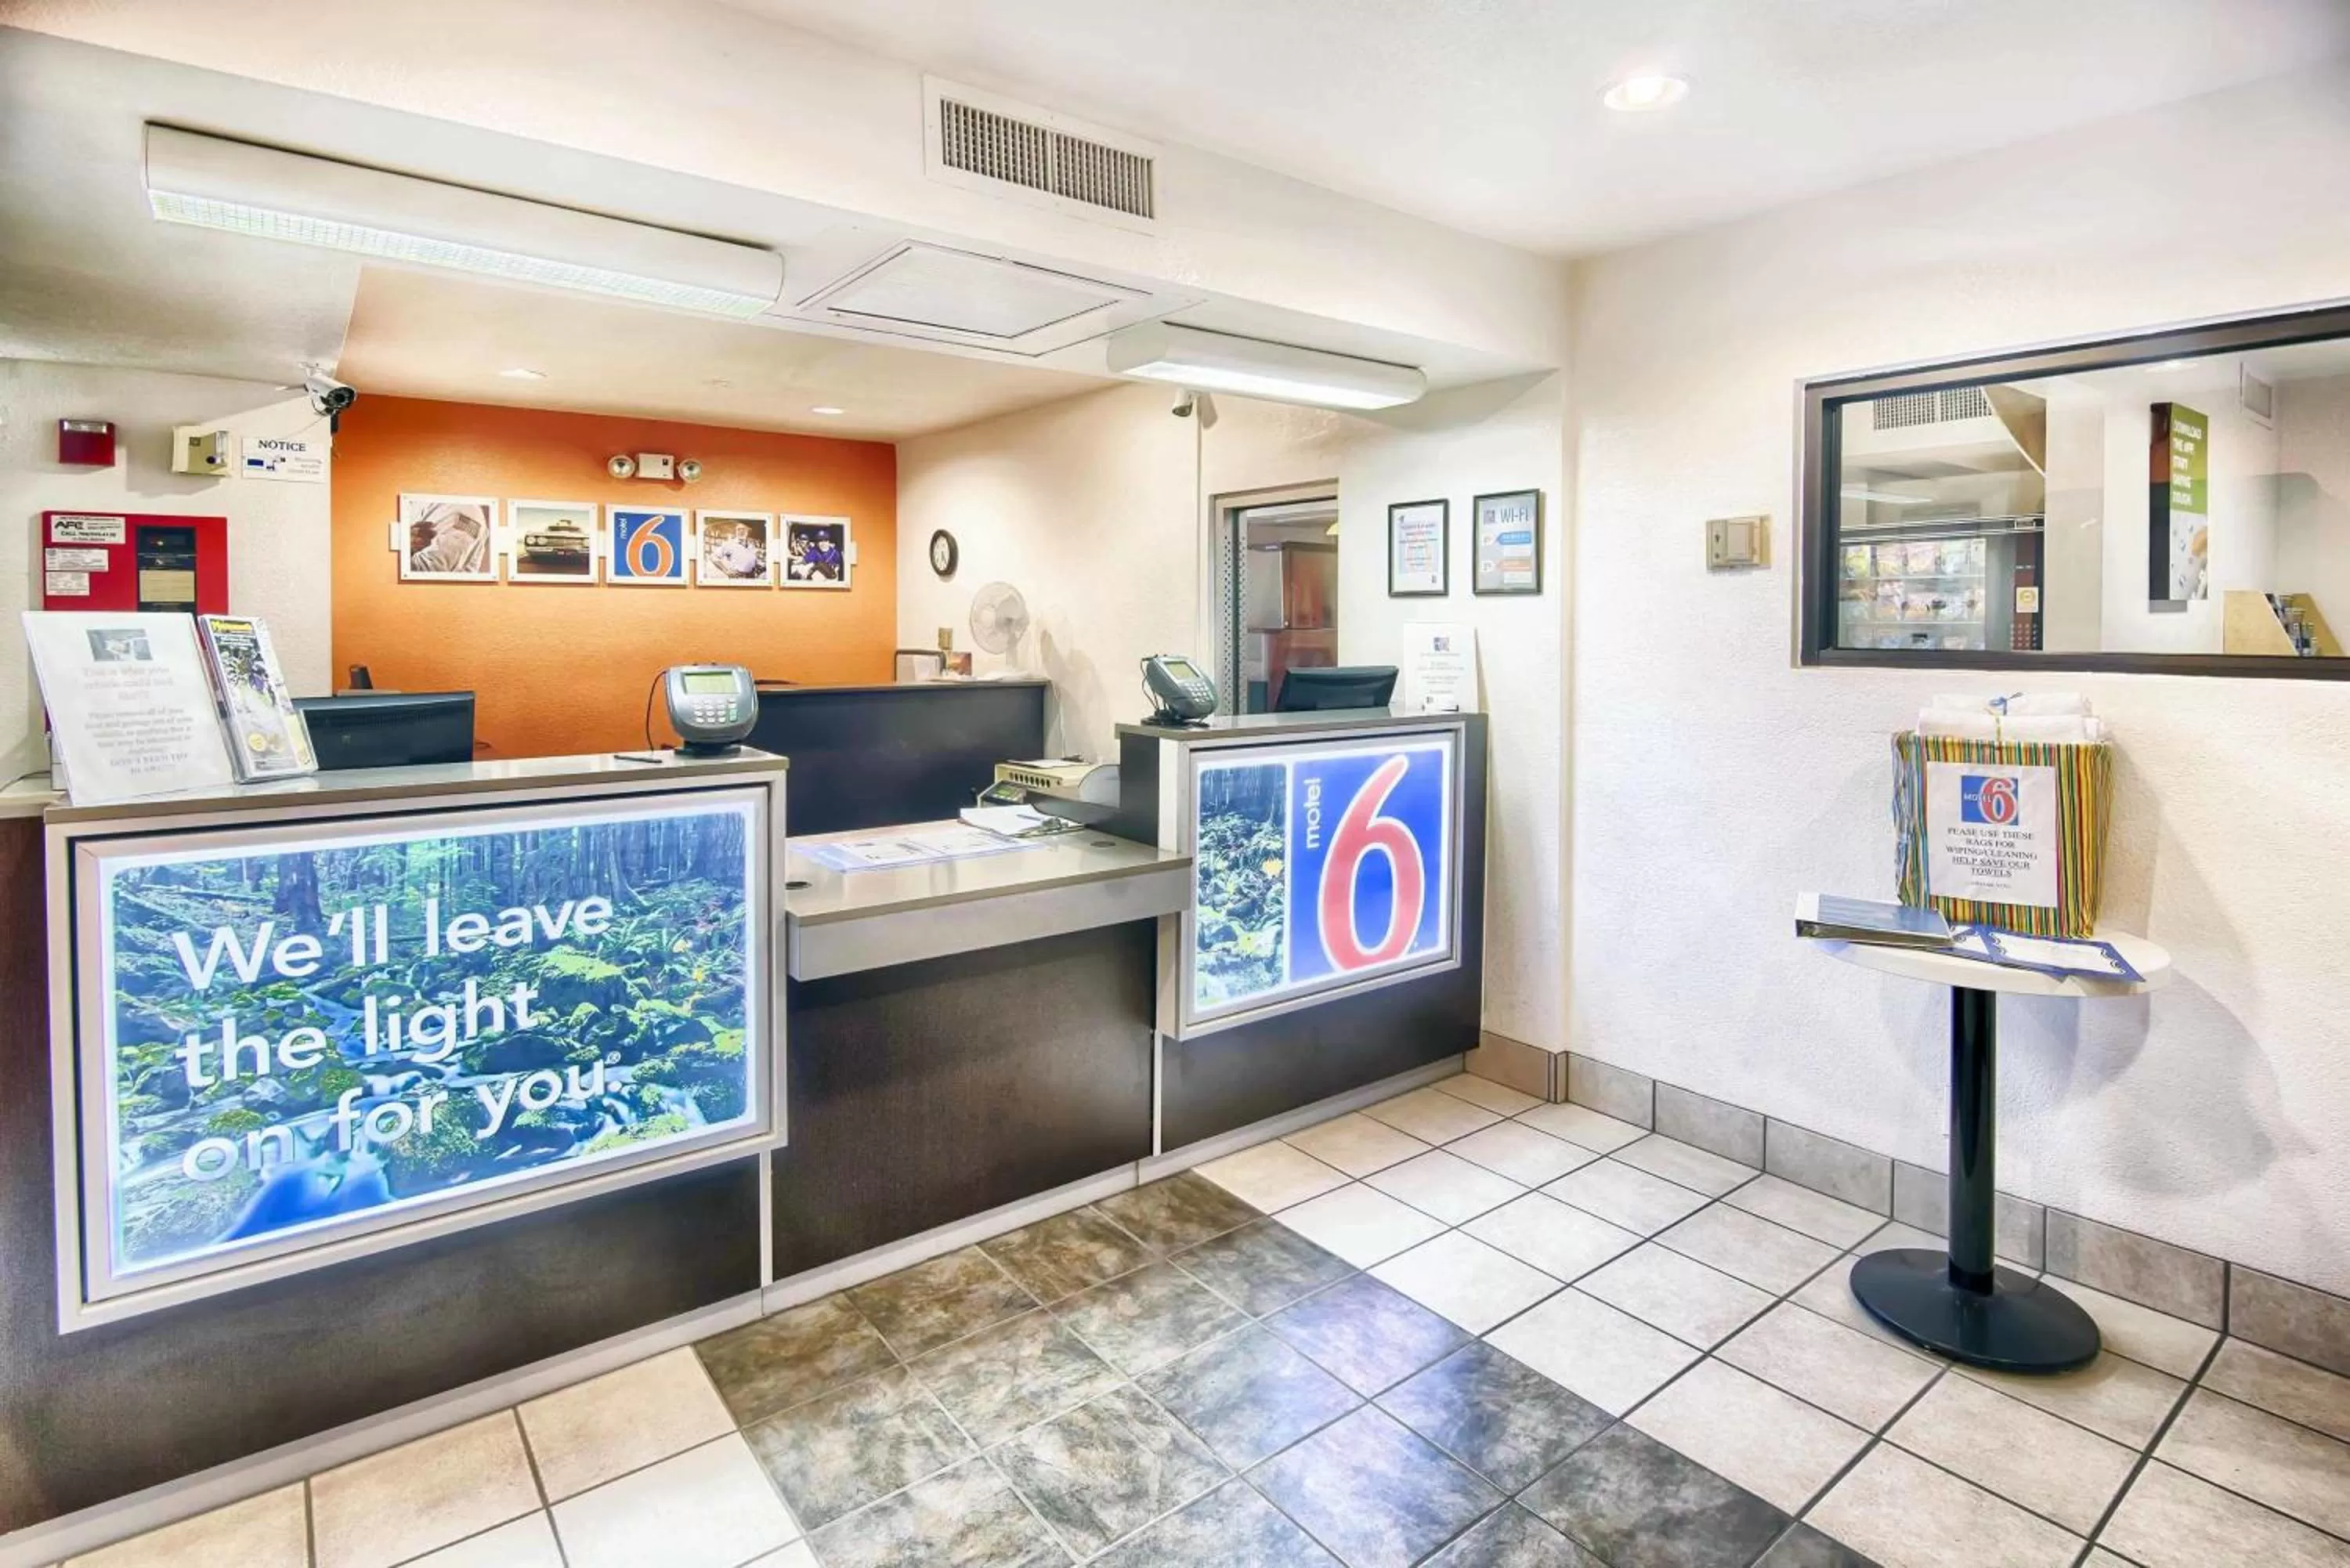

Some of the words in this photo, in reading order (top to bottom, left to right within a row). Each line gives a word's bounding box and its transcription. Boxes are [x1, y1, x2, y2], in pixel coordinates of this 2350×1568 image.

[258, 439, 306, 452] NOTICE
[1500, 507, 1528, 523] WI-FI
[619, 518, 627, 540] motel
[626, 514, 674, 577] 6
[1979, 776, 2018, 824] 6
[1979, 829, 2000, 838] USE
[2002, 830, 2034, 840] THESE
[1995, 840, 2016, 848] FOR
[1303, 777, 1322, 850] motel
[1317, 753, 1426, 974] 6
[1952, 856, 1978, 865] HELP
[1979, 858, 2006, 869] SAVE
[2008, 861, 2031, 871] OUR
[1971, 867, 2012, 877] TOWELS
[173, 904, 389, 992] We'll
[425, 894, 614, 957] leave
[176, 1017, 327, 1088] the
[363, 979, 539, 1064] light
[182, 1124, 296, 1183] on
[329, 1086, 449, 1152] for
